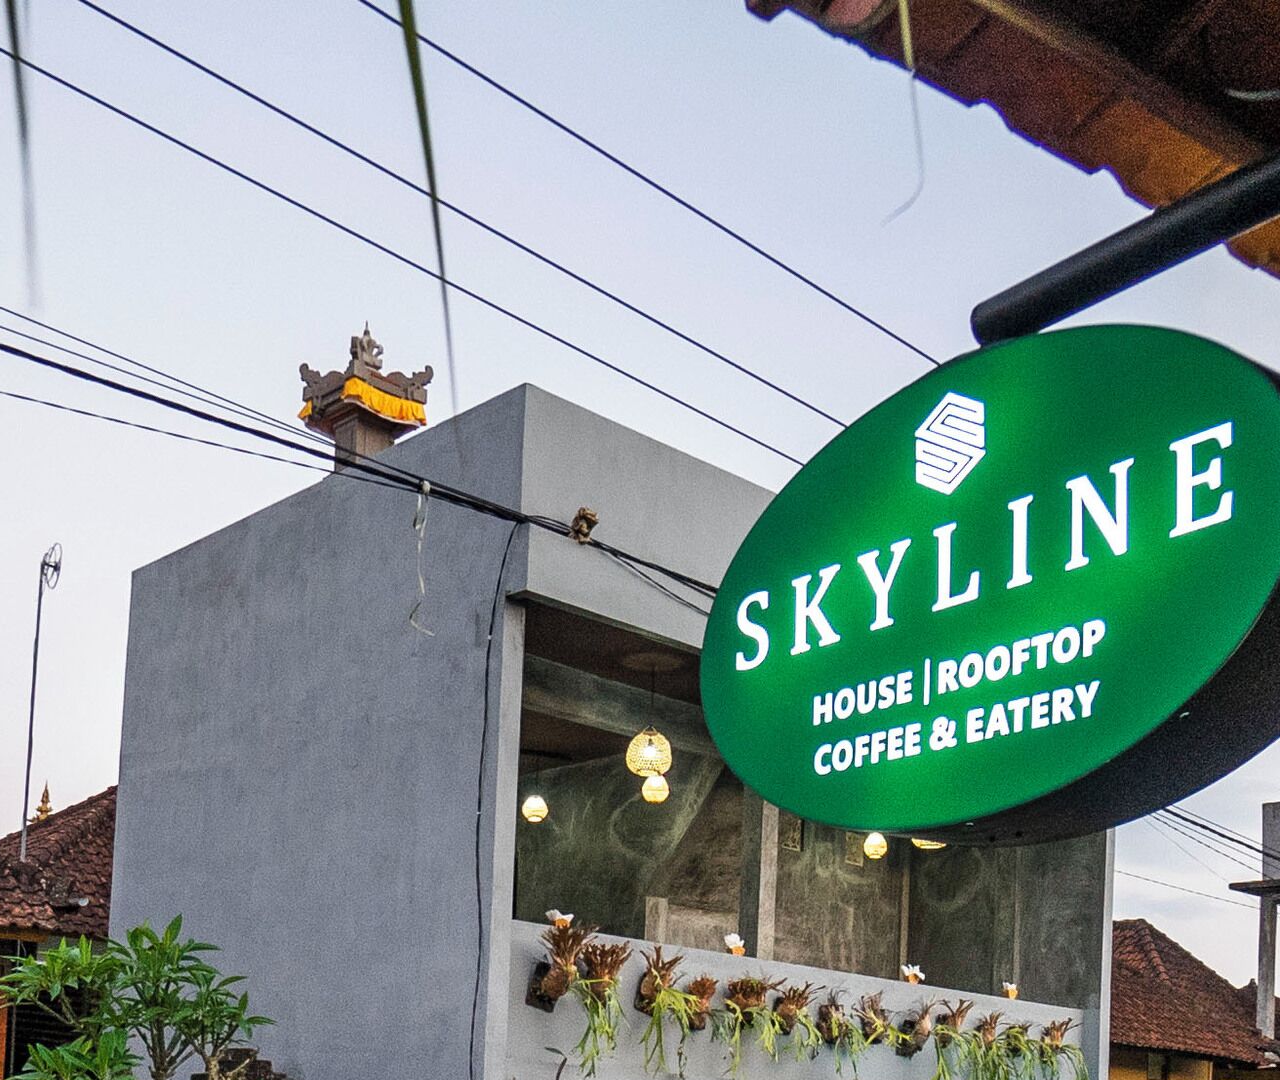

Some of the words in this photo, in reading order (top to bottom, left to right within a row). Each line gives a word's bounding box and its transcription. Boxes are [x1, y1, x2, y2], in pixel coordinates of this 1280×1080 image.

[734, 420, 1234, 672] SKYLINE
[813, 670, 913, 726] HOUSE
[937, 618, 1106, 695] ROOFTOP
[813, 722, 922, 776] COFFEE
[929, 716, 958, 751] &
[966, 680, 1101, 744] EATERY
